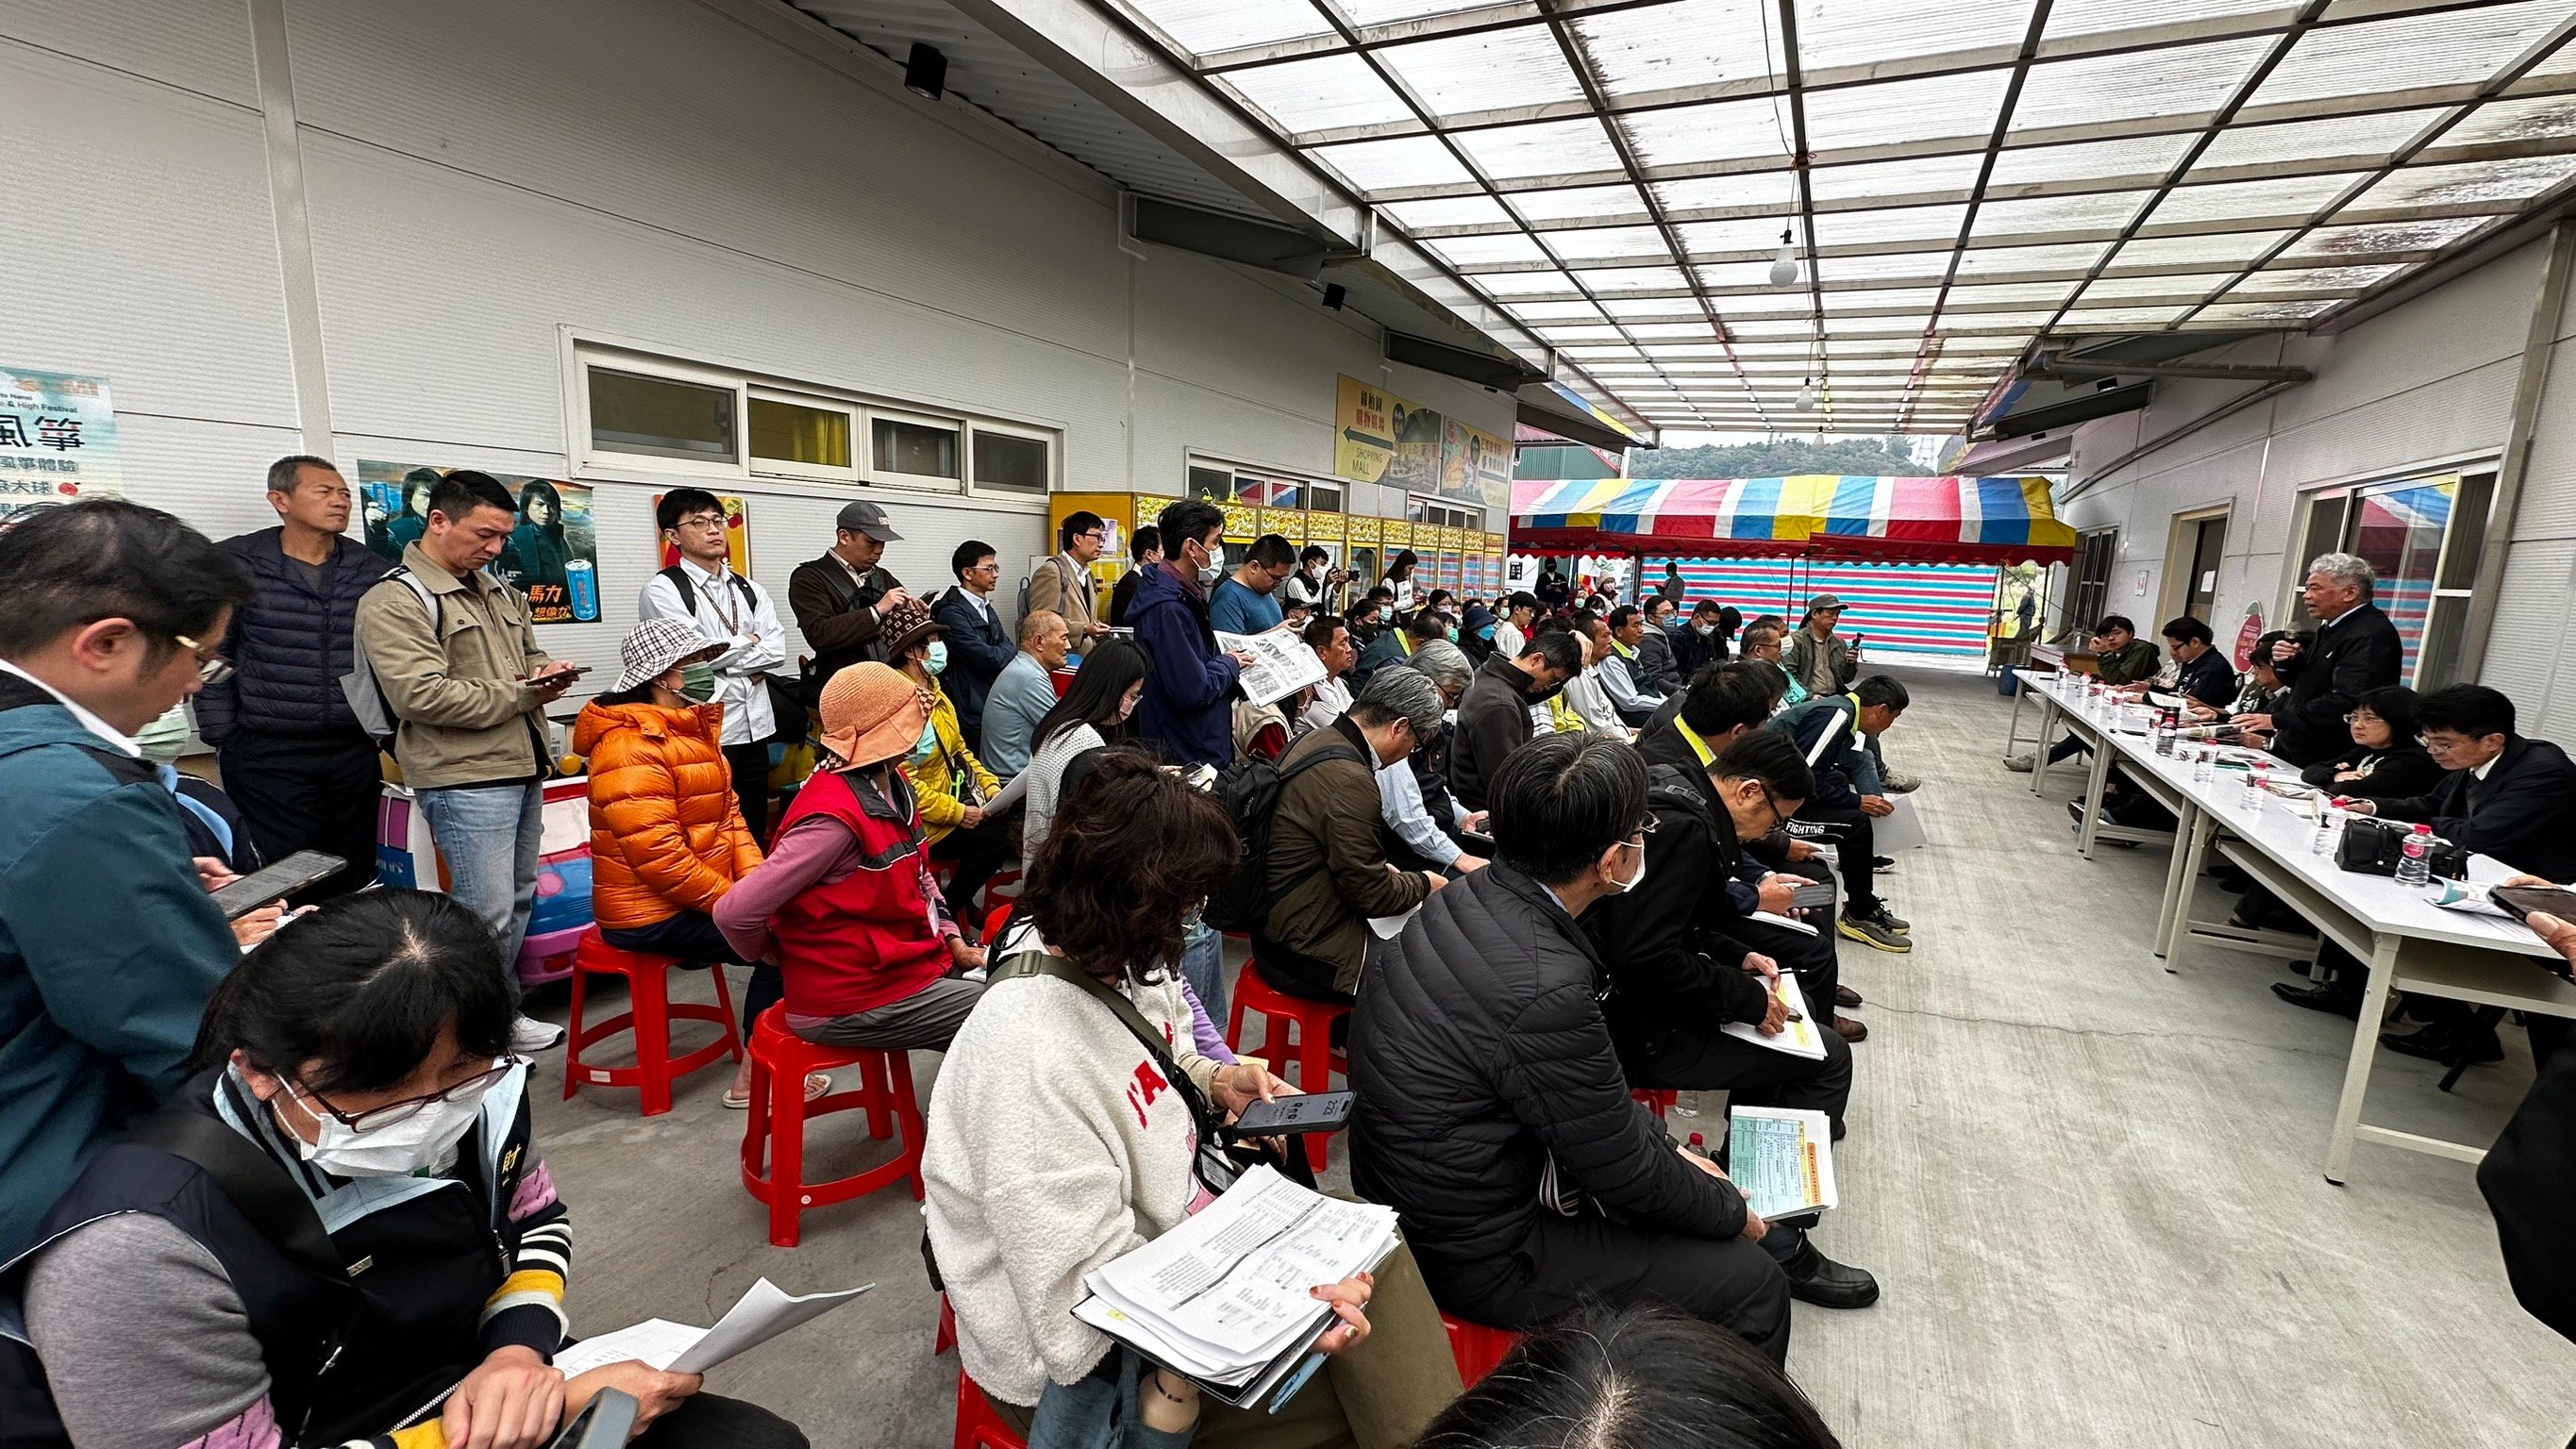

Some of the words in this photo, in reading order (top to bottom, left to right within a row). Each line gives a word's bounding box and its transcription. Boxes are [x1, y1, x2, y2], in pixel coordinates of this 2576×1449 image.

[17, 401, 39, 410] High
[42, 403, 77, 413] Festival
[1356, 447, 1382, 463] SHOPPING
[1352, 459, 1370, 475] MALL
[1785, 822, 1825, 835] FIGHTING
